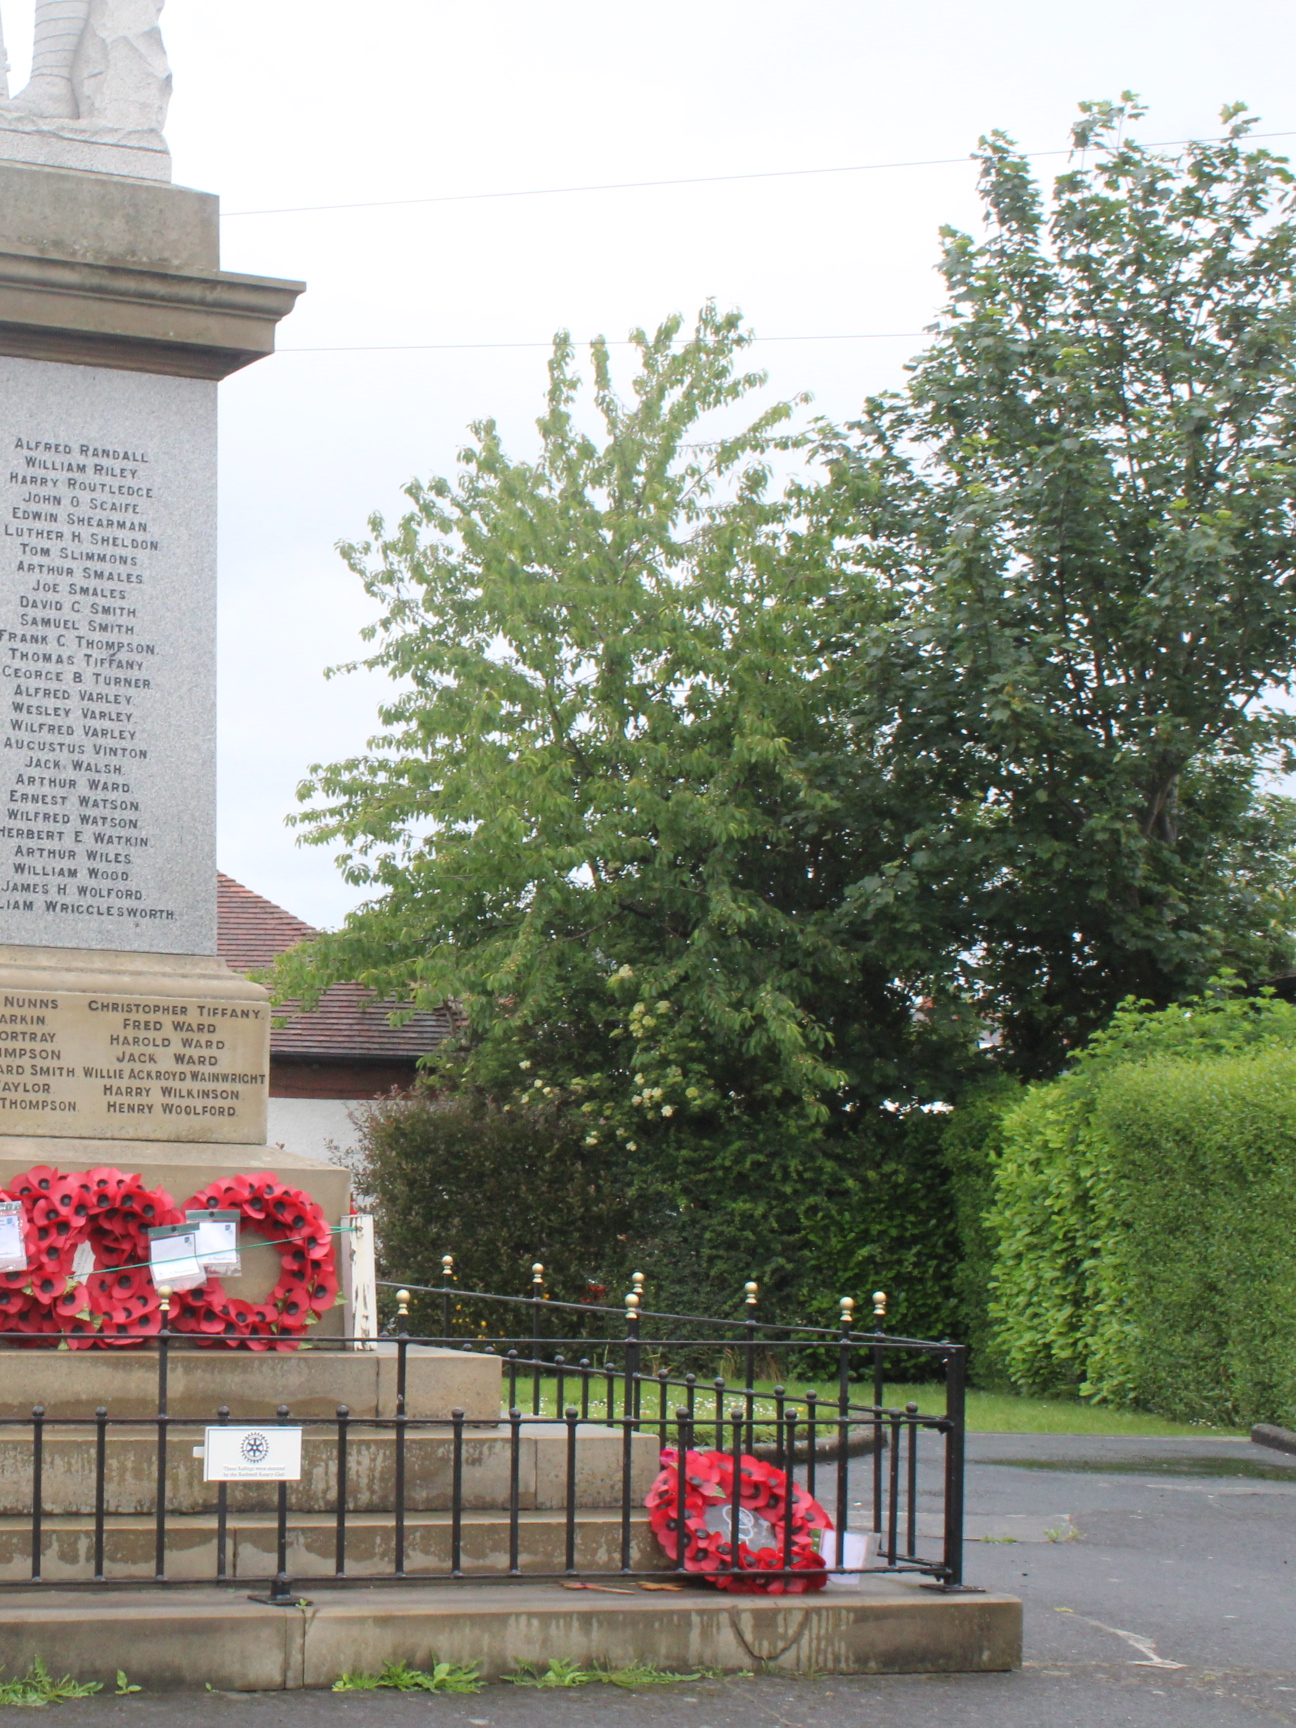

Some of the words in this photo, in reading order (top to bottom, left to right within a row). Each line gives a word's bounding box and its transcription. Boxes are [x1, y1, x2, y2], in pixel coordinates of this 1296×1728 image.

[14, 437, 72, 454] ALFRED
[24, 455, 87, 473] WILLIAM
[9, 471, 59, 487] HARRY
[22, 491, 62, 506] JOHN
[12, 506, 58, 523] EDWIN
[4, 522, 64, 541] LUTHER
[19, 542, 51, 557] TOM
[16, 560, 74, 577] ARTHUR
[31, 579, 60, 593] JOE
[19, 595, 63, 611] DAVID
[20, 612, 80, 630] SAMUEL
[8, 647, 75, 665] THOMAS
[13, 683, 70, 700] ALFRED
[11, 700, 71, 717] WESLEY
[9, 718, 75, 735] WILFRED
[15, 773, 77, 789] ARTHUR
[9, 789, 68, 805] ERNEST
[6, 807, 70, 824] WILFRED
[14, 844, 76, 860] ARTHUR
[12, 862, 78, 878] WILLIAM
[0, 879, 49, 894] JAMES
[87, 999, 188, 1015] CHRISTOPHER
[123, 1018, 163, 1031] FRED
[171, 1020, 217, 1033] WARD
[109, 1034, 171, 1047] HAROLD
[116, 1050, 157, 1063] JACK
[82, 1066, 124, 1079] WILLIE
[127, 1068, 187, 1081] ACKROYD
[189, 1070, 265, 1084] WAINWRIGHT
[103, 1084, 152, 1097] HARRY
[107, 1100, 154, 1114] HENRY
